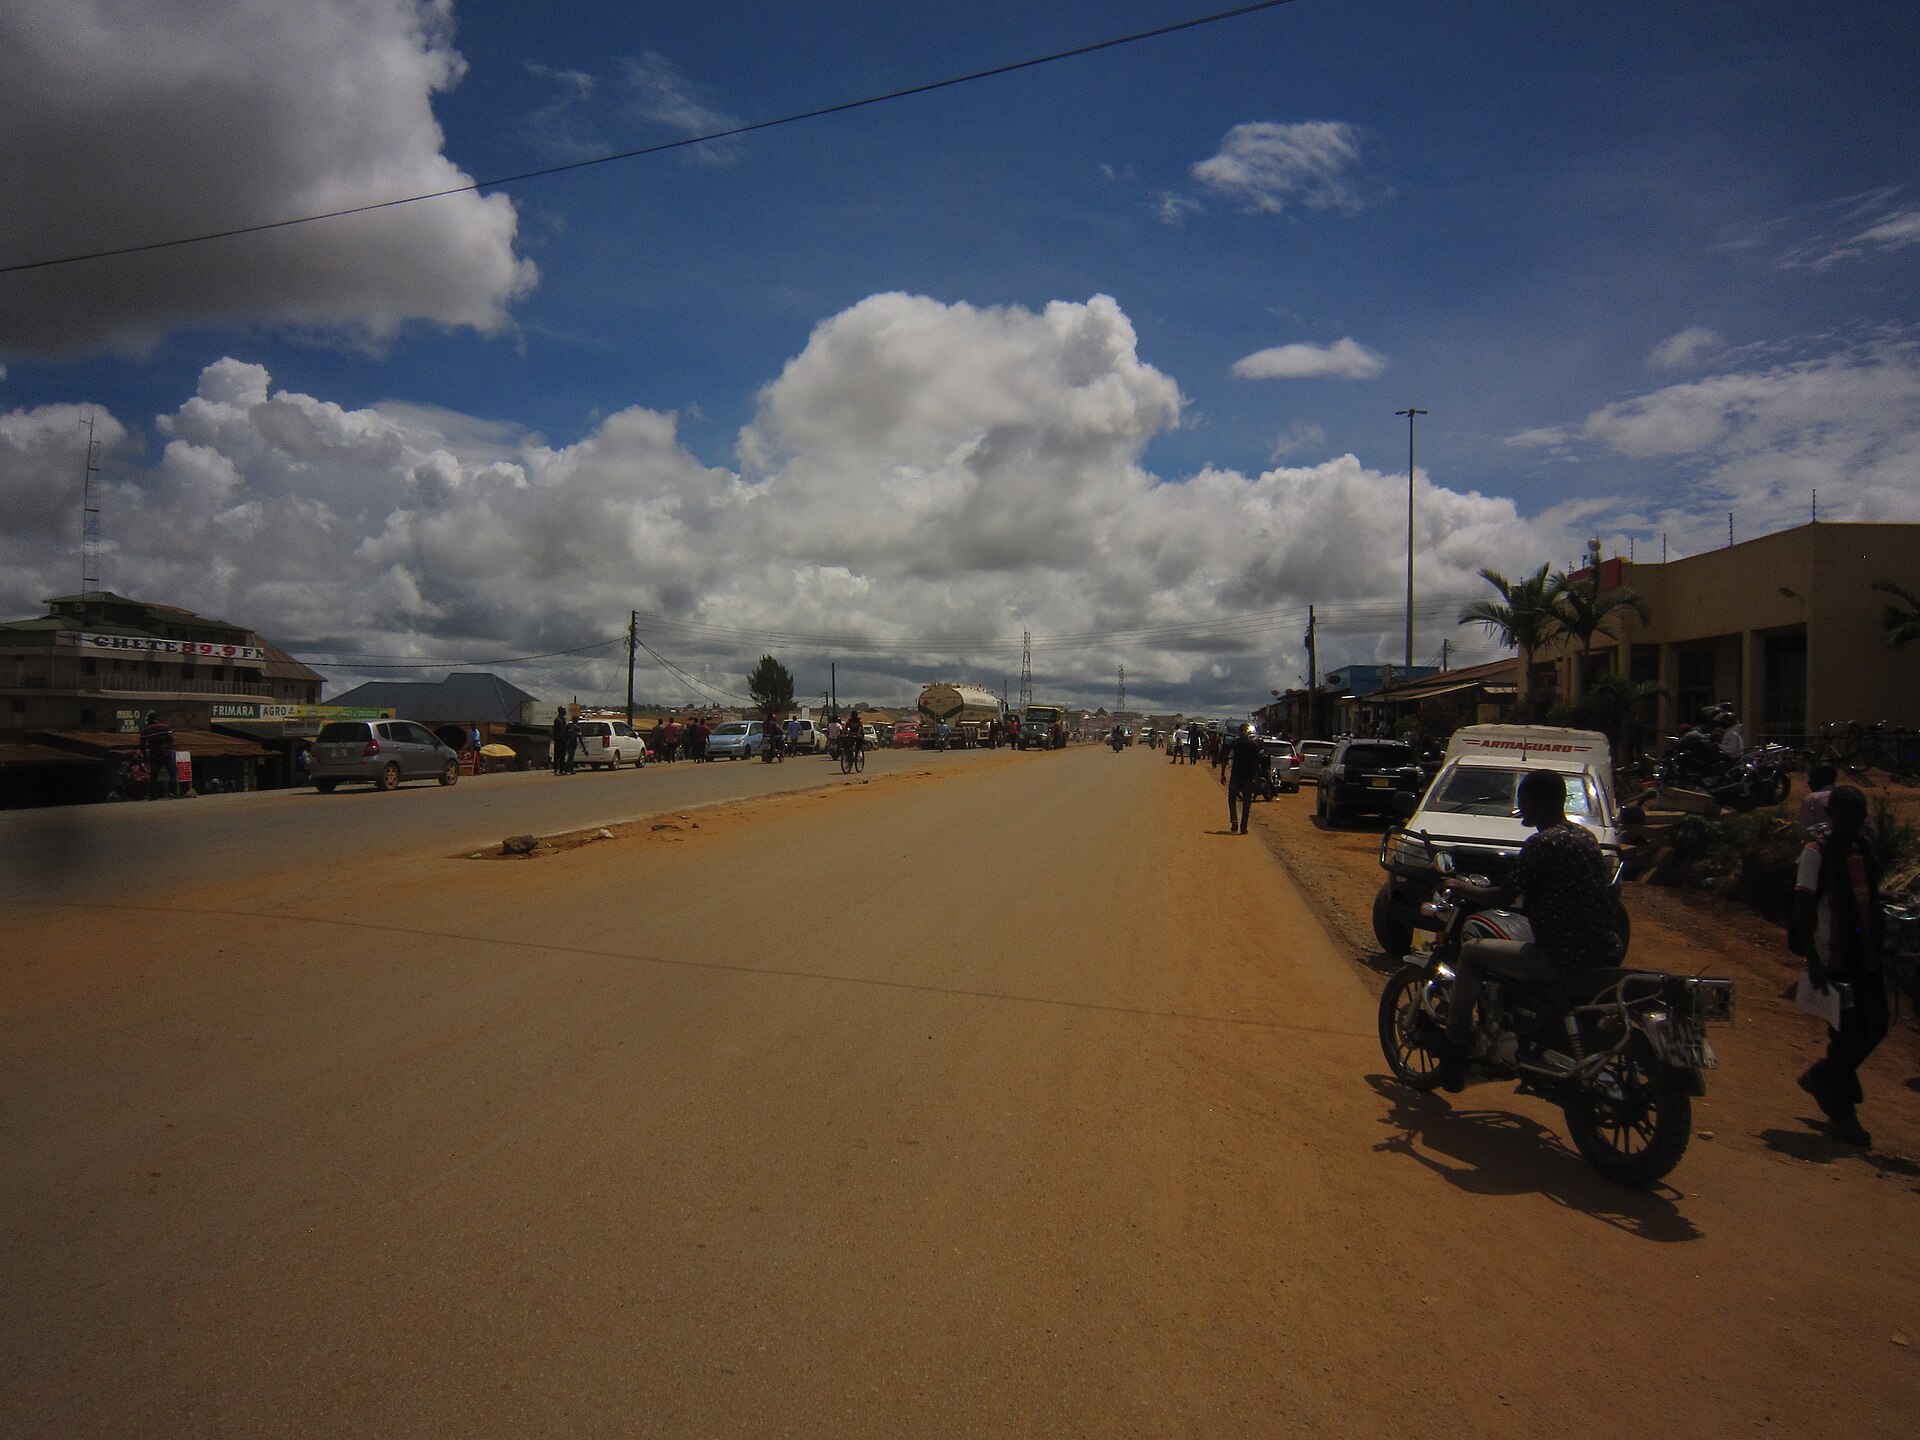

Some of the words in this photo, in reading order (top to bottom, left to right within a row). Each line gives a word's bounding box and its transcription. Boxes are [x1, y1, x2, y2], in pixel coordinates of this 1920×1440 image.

[182, 642, 236, 656] 89.9
[213, 705, 254, 716] FRIMARA
[263, 706, 286, 716] AGRO
[1480, 740, 1573, 753] ARMAGUARD
